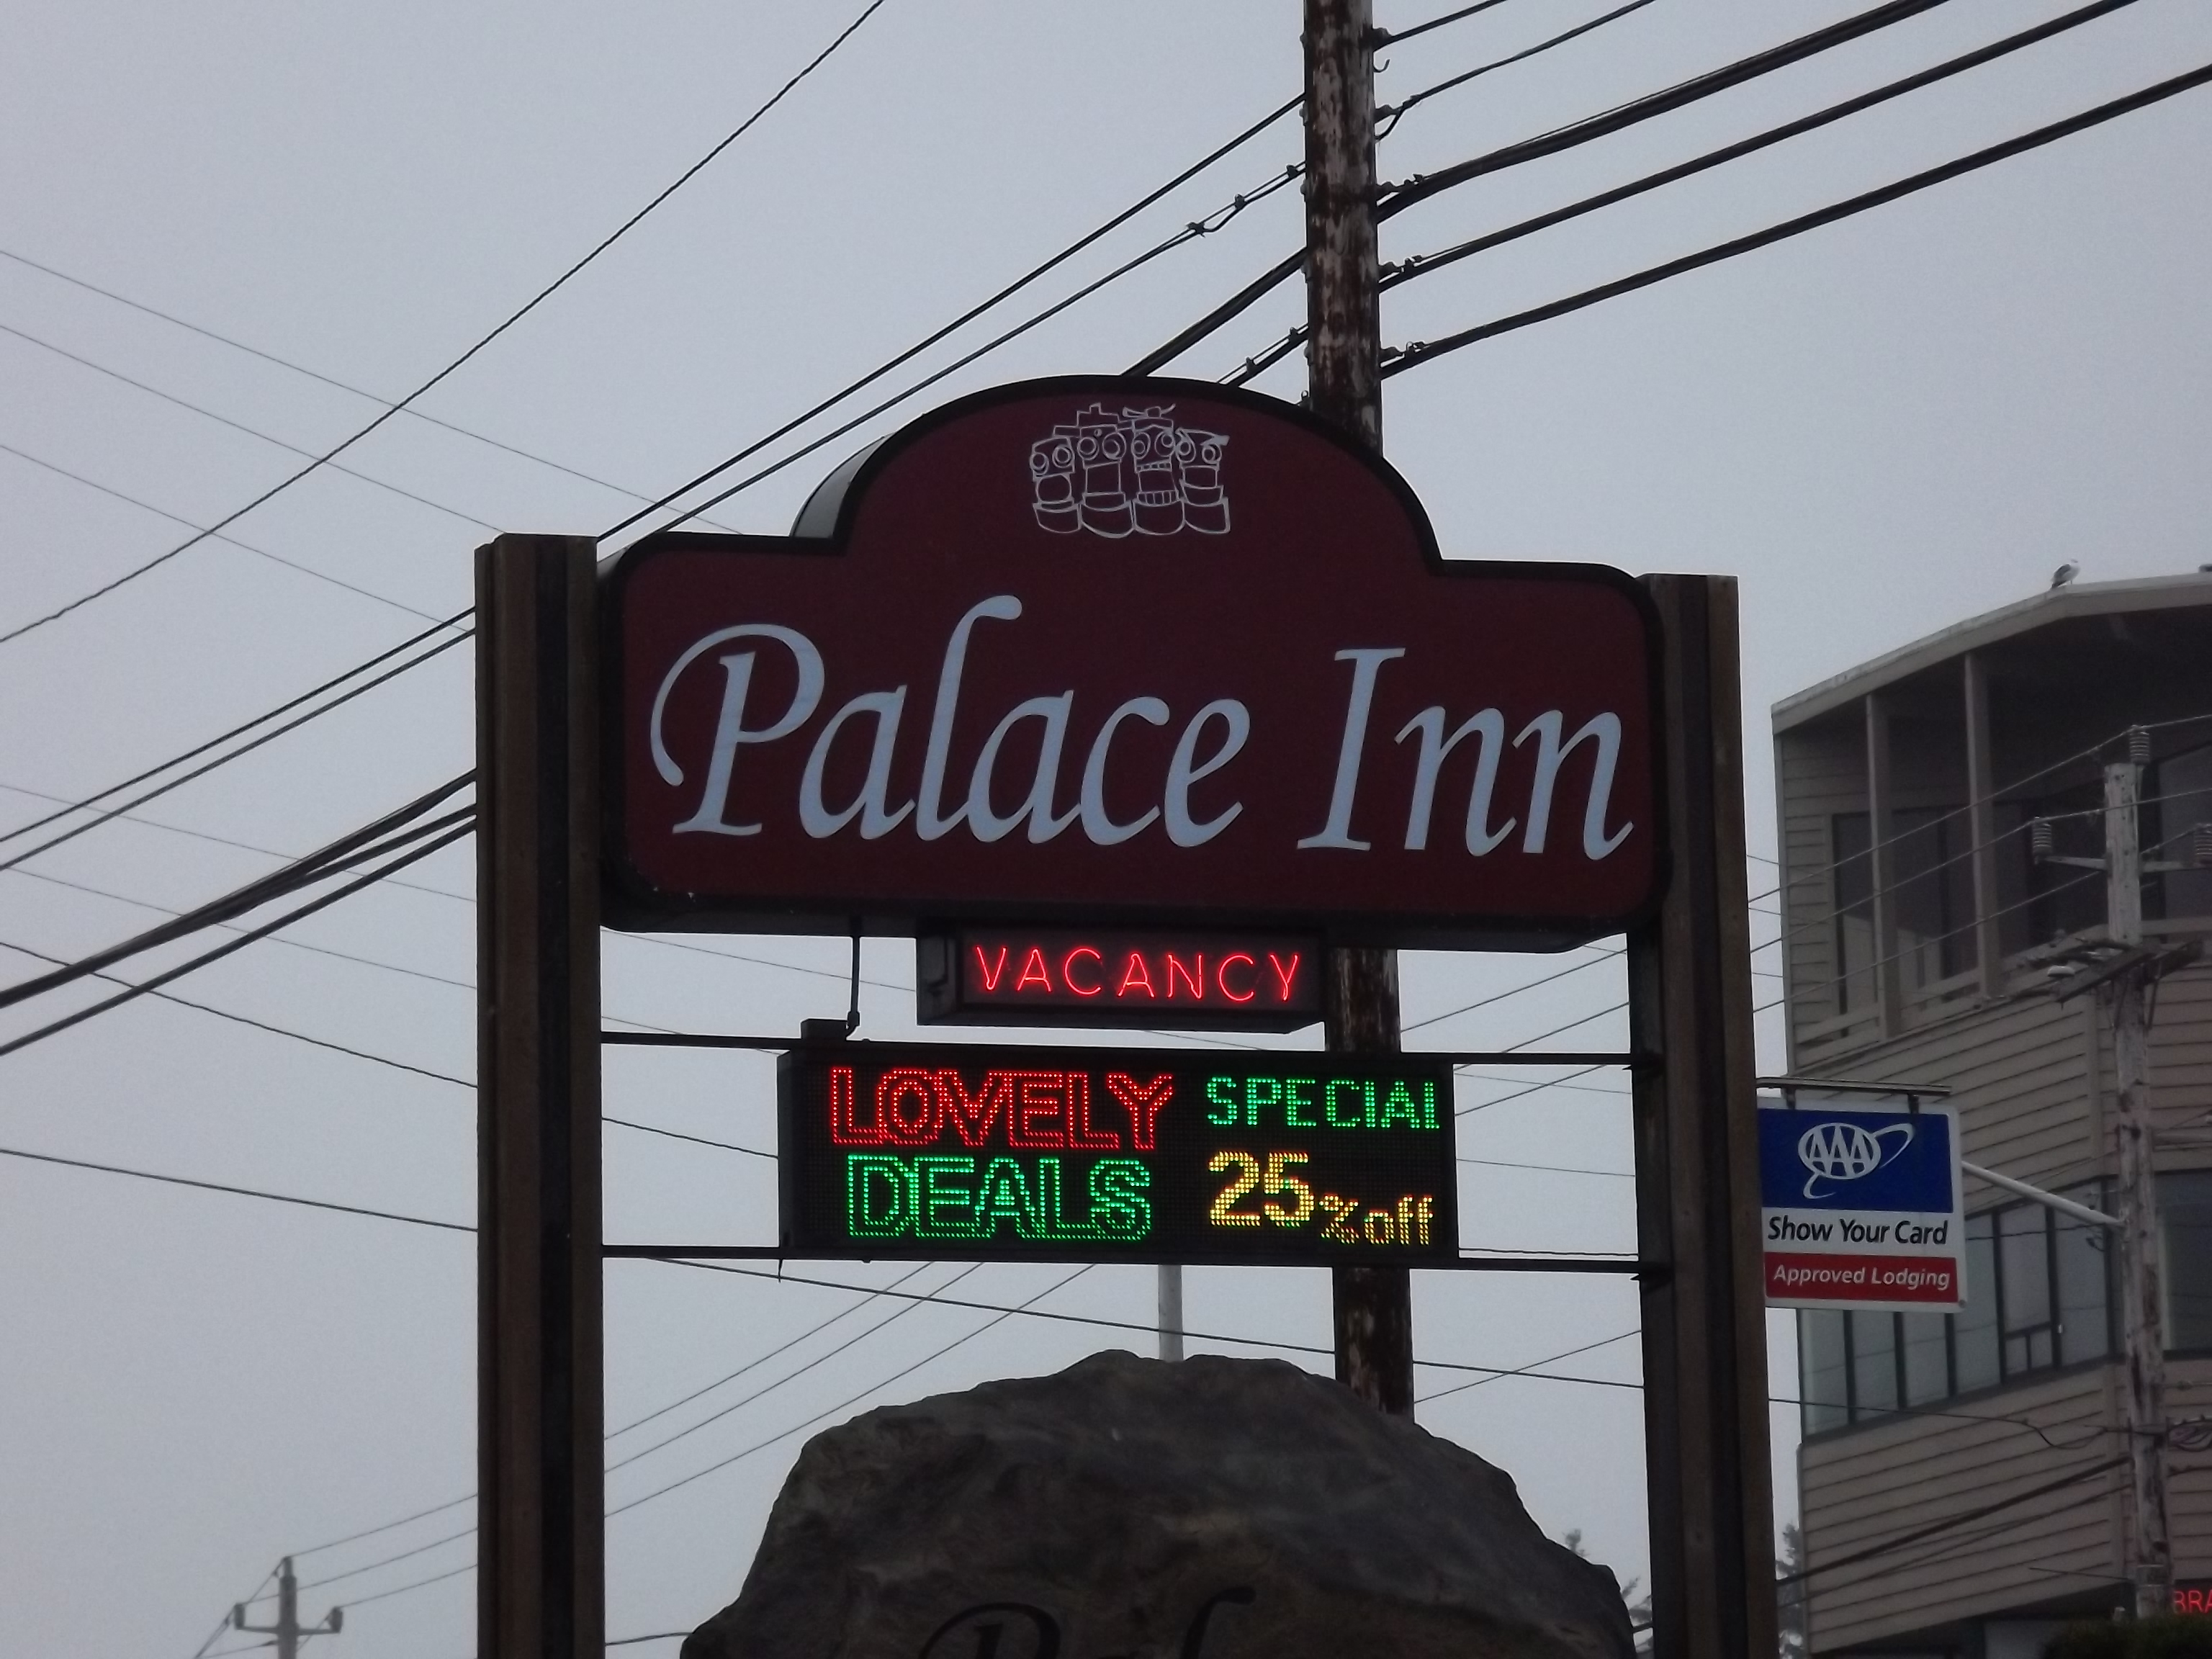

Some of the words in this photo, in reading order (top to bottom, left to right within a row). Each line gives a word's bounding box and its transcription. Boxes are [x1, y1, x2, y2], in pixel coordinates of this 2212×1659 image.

[650, 595, 1250, 848] Palace
[1297, 648, 1635, 860] Inn
[976, 946, 1298, 1002] VACANCY
[831, 1067, 1174, 1149] LOVELY
[1207, 1077, 1439, 1129] SPECIAL
[1804, 1123, 1877, 1179] AAA
[848, 1154, 1151, 1240] DEALS
[1768, 1215, 1833, 1241] Show
[1840, 1218, 1889, 1242] Your
[1894, 1220, 1948, 1245] Card
[1773, 1264, 1866, 1286] Approved
[1872, 1267, 1950, 1290] Lodging
